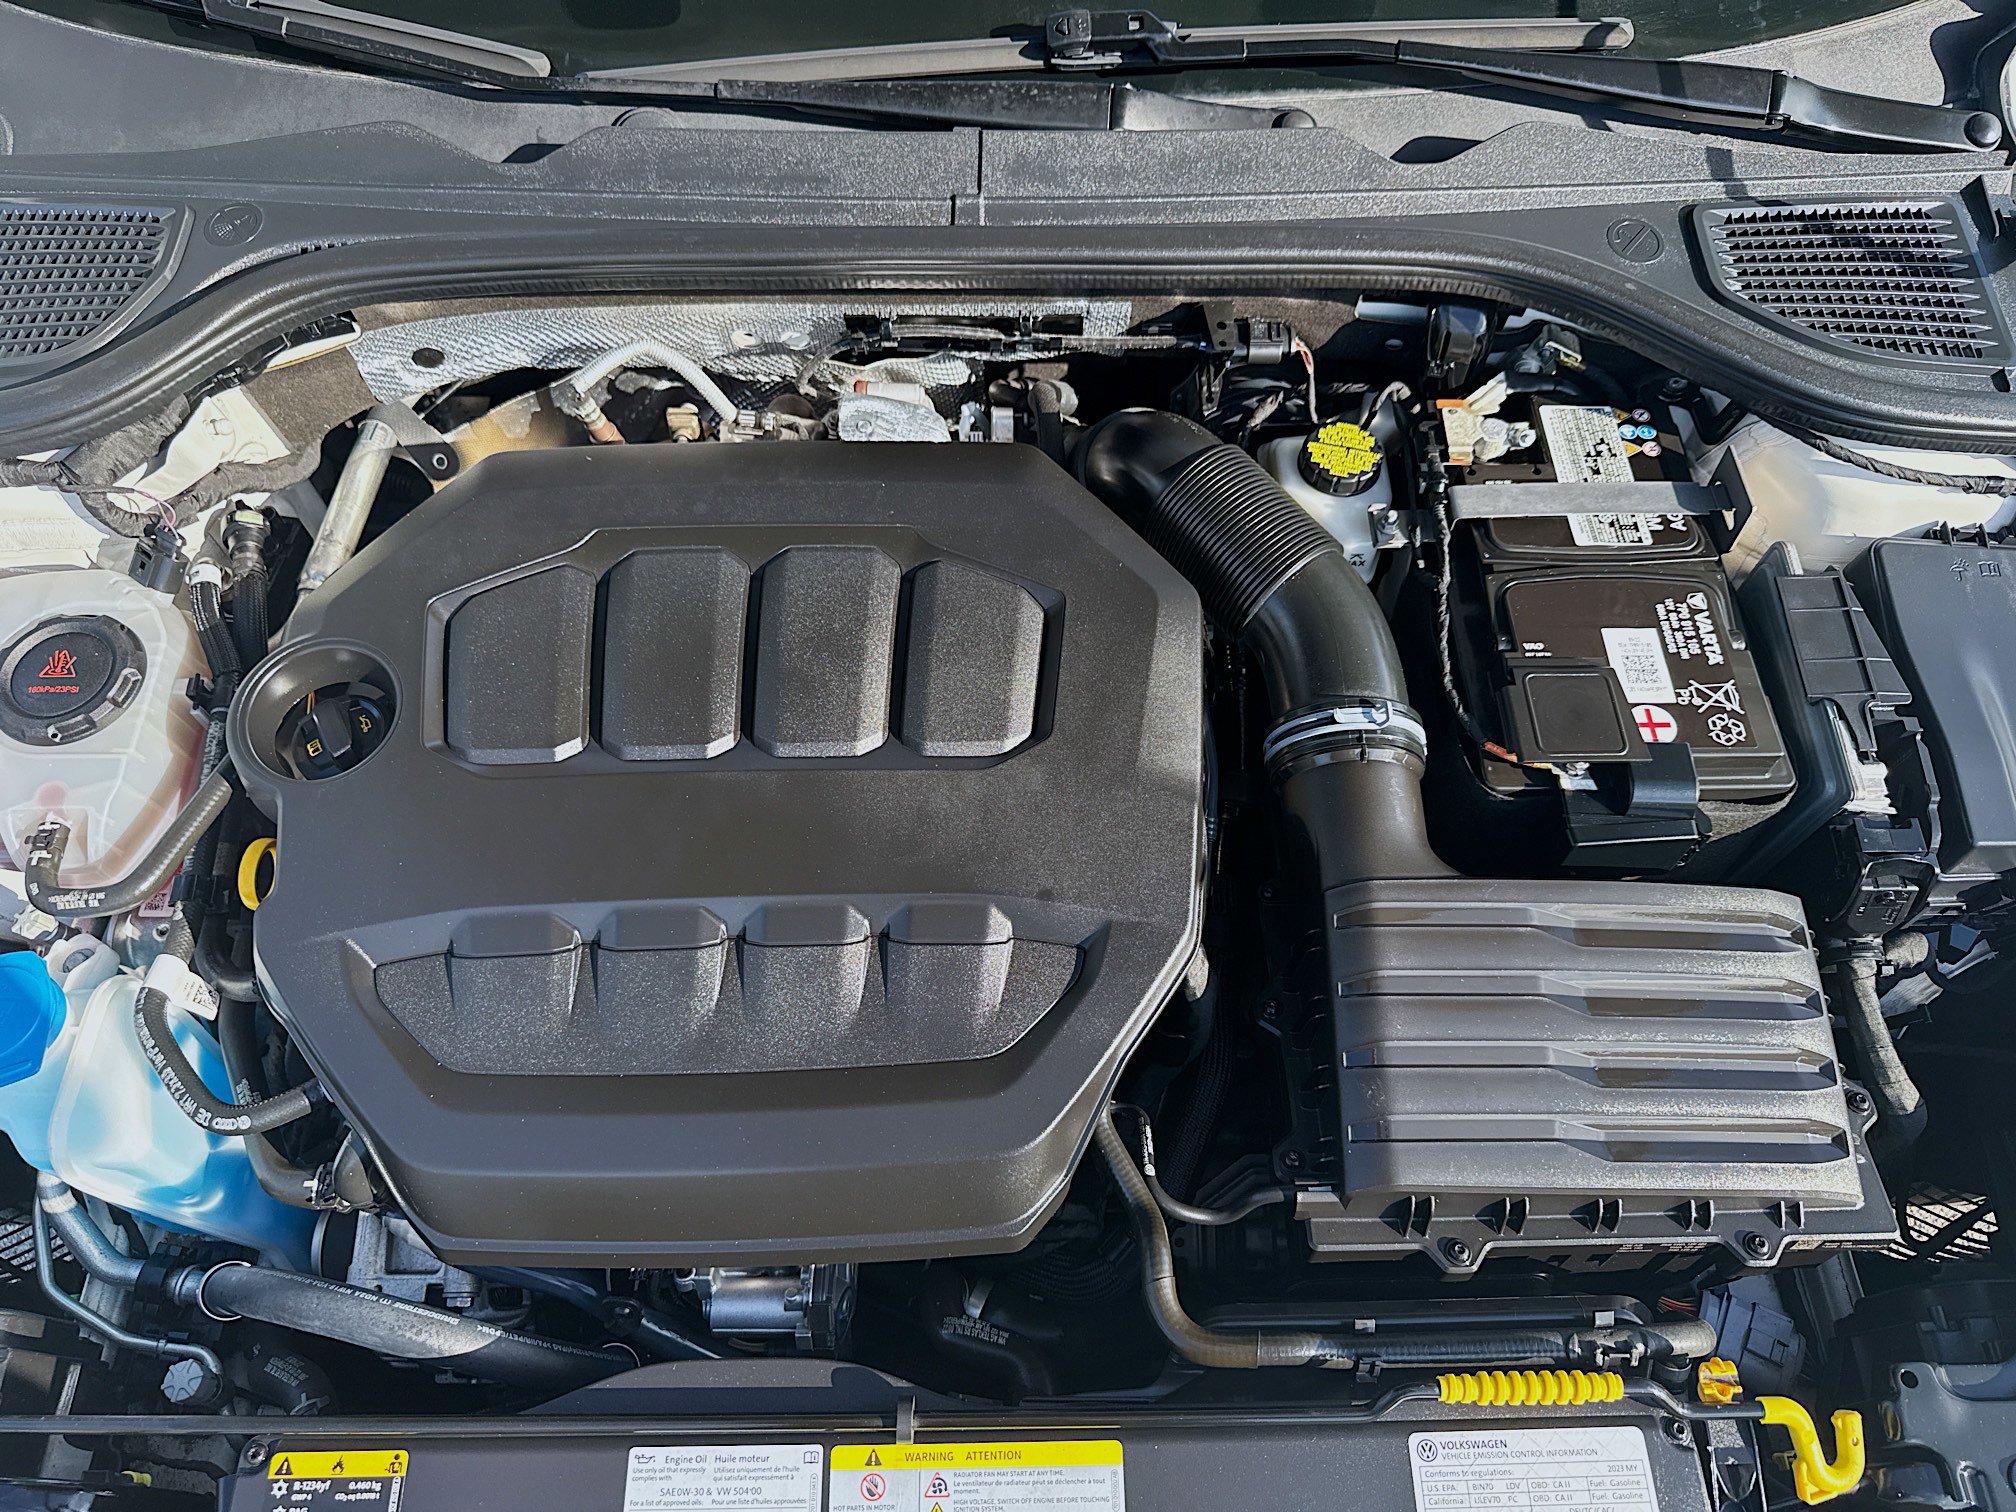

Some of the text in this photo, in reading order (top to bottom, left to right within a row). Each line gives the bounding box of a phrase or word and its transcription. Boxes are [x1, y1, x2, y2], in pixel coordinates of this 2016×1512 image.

[1694, 611, 1724, 666] VARTA
[1686, 638, 1701, 654] 105
[1675, 687, 1690, 706] Pb
[393, 1301, 460, 1325] BRIDGESTONE
[1439, 1440, 1508, 1450] VOLKSWAGEN
[715, 1454, 769, 1463] Huile moteur
[905, 1450, 1022, 1462] WARNING ATTENTION
[1441, 1449, 1598, 1460] VEHICLE EMISSION CONTROL INFORMATION
[665, 1455, 707, 1466] Engine Oil
[645, 1467, 657, 1475] only
[680, 1466, 706, 1475] expressly
[736, 1466, 773, 1475] uniquement
[1424, 1470, 1460, 1478] Conforms
[1471, 1469, 1514, 1478] regulations:
[632, 1475, 657, 1483] complies
[748, 1474, 789, 1482] expressément
[1031, 1479, 1046, 1487] peut
[371, 1481, 382, 1492] kg
[1472, 1483, 1494, 1491] BIN70
[1506, 1482, 1521, 1490] LDV
[1553, 1481, 1564, 1489] CA
[1610, 1479, 1641, 1487] Gasoline
[706, 1488, 712, 1496] &
[717, 1487, 732, 1496] VW
[773, 1498, 807, 1506] approuvées
[1428, 1496, 1466, 1505] California:
[1508, 1495, 1518, 1503] PC
[1555, 1494, 1567, 1502] CA
[1612, 1492, 1643, 1500] Gasoline
